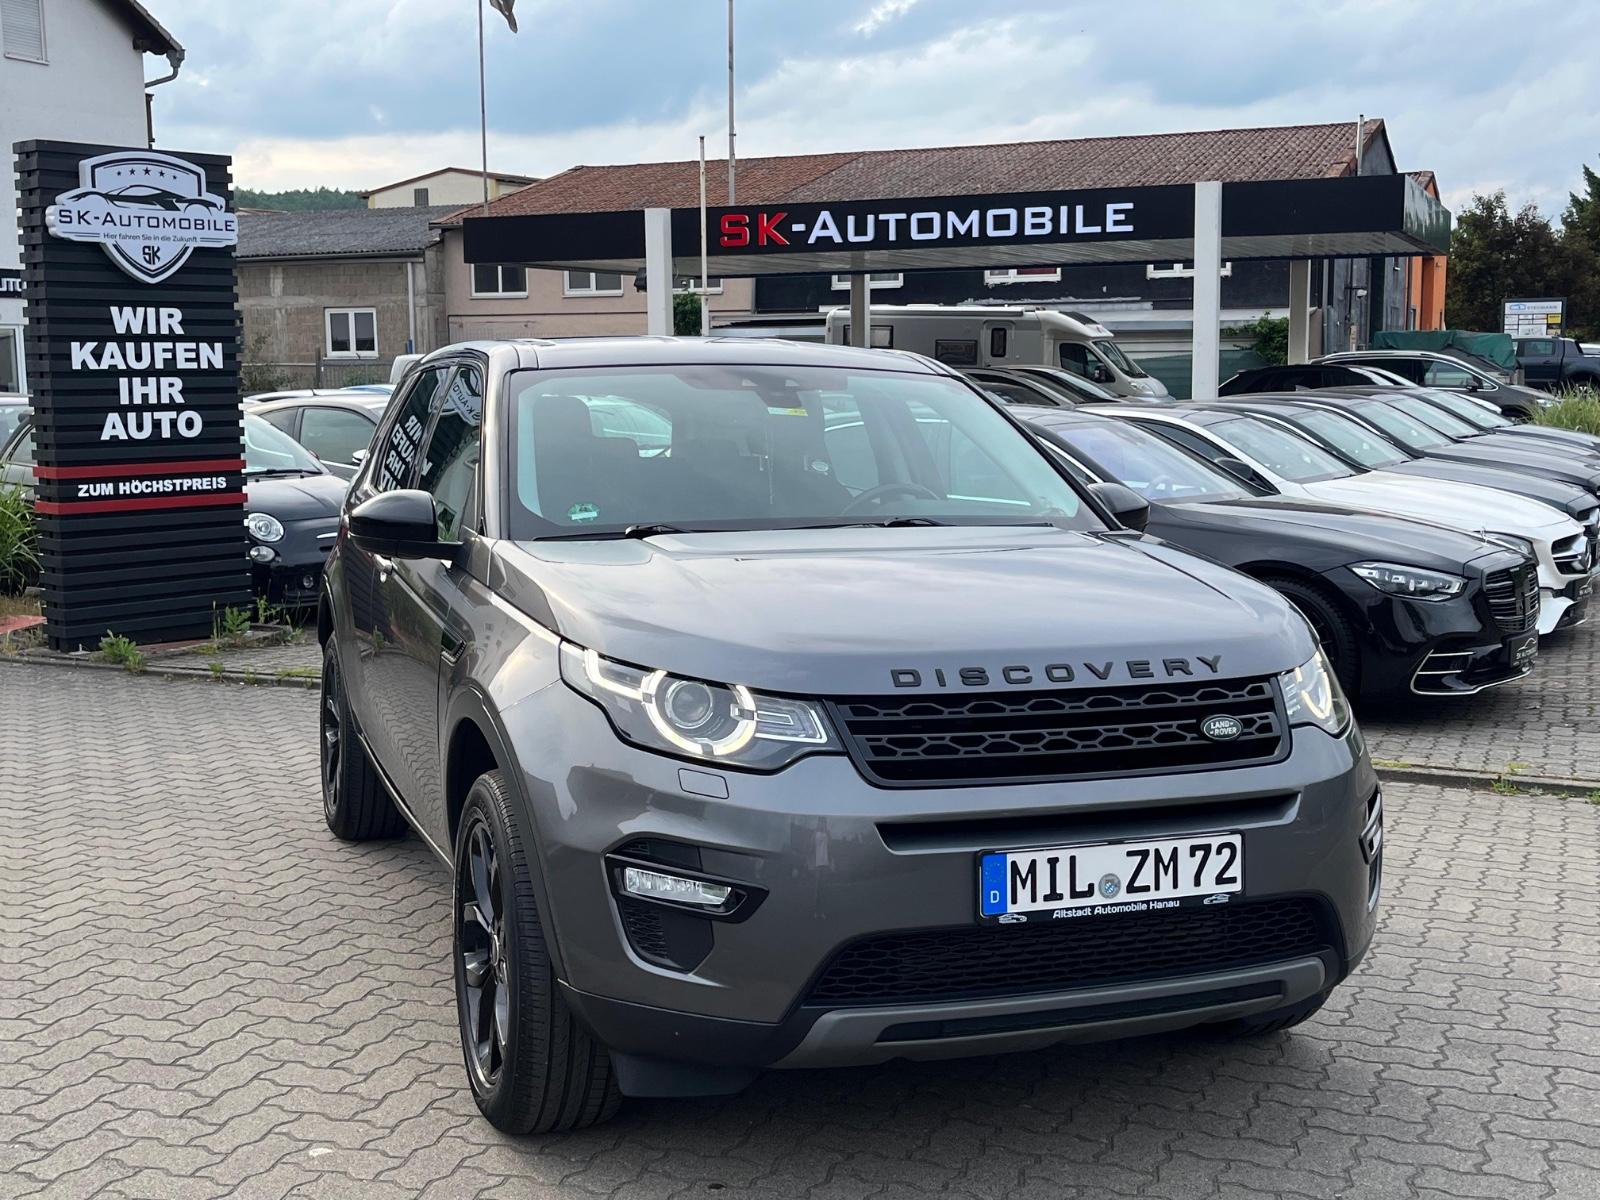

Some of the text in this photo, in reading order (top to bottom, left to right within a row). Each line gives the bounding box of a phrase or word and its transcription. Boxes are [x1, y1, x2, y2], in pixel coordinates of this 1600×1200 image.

[58, 209, 236, 232] SK-AUTOMOBILE
[719, 203, 1135, 248] SK-AUTOMOBILE
[103, 232, 117, 240] Hier
[119, 233, 141, 241] fahren
[142, 233, 153, 241] Sie
[161, 234, 172, 242] die
[172, 235, 198, 243] Zukunft
[142, 245, 161, 265] SK
[110, 306, 185, 336] WIR
[70, 341, 224, 370] KAUFEN
[118, 376, 186, 405] IHR
[100, 410, 203, 441] AUTO
[78, 476, 227, 497] ZUM HÖCHSTPREIS
[890, 655, 1223, 688] DISCOVERY
[990, 841, 1238, 904] D MIL ZM 72
[1052, 899, 1180, 919] Altstadt Automobile Hanau
